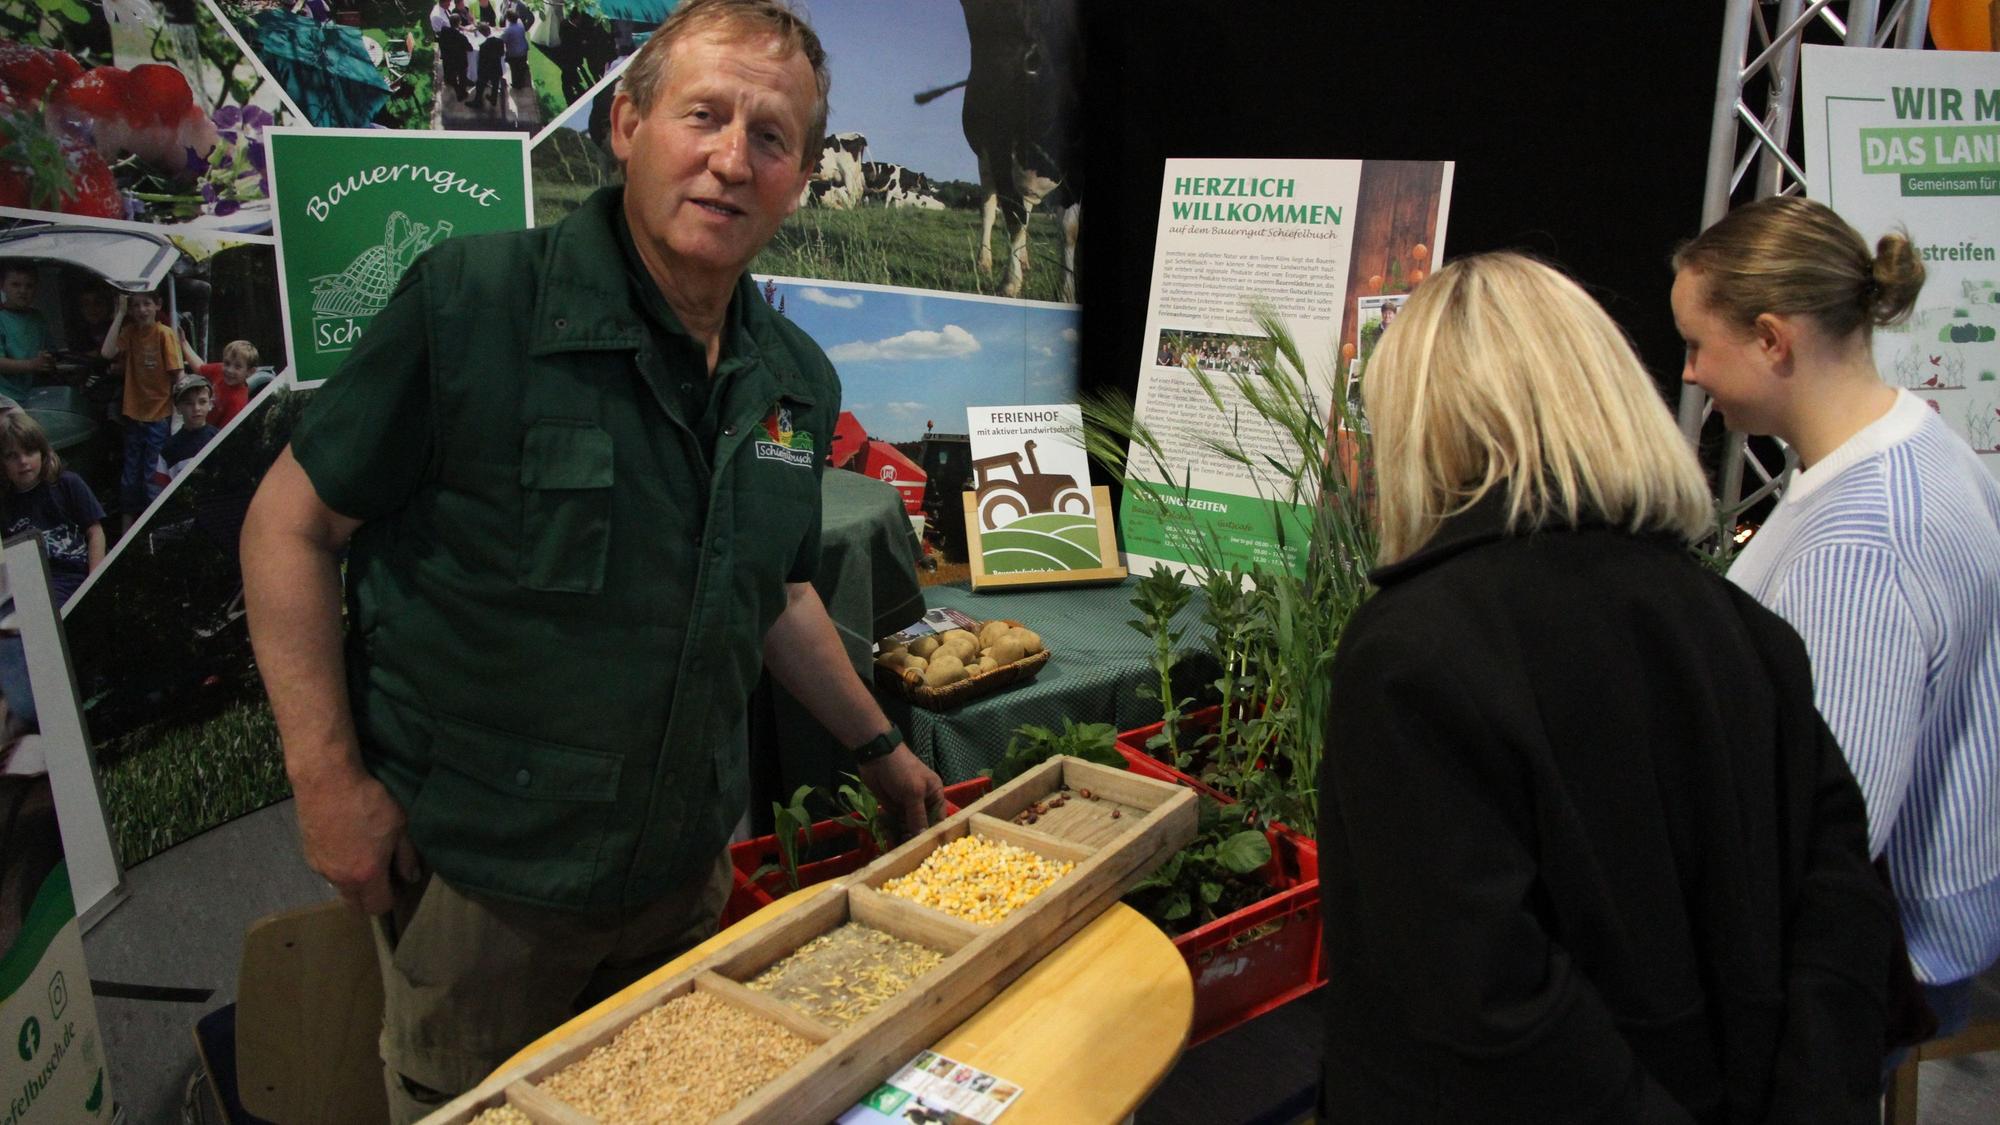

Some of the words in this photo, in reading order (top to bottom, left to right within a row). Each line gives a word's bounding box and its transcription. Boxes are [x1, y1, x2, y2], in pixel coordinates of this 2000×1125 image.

[1891, 86, 1964, 121] WIR
[1866, 136, 1927, 166] DAS
[1934, 134, 2000, 165] LAN
[306, 163, 501, 222] Bauerngut
[1174, 177, 1295, 198] HERZLICH
[1908, 177, 1977, 191] Gemeinsam
[1980, 176, 1996, 190] für
[1172, 201, 1343, 226] WILLKOMMEN
[1169, 225, 1186, 235] auf
[1188, 225, 1209, 235] dem
[1212, 226, 1267, 239] Bauerngut
[1268, 228, 1337, 240] Schiefelbusch
[318, 318, 362, 347] Sch
[991, 411, 1059, 424] FERIENHOF
[977, 428, 991, 436] mit
[992, 427, 1018, 436] aktiver
[1020, 425, 1077, 436] Landwirtschaft
[1133, 491, 1228, 513] UNGZEITEN
